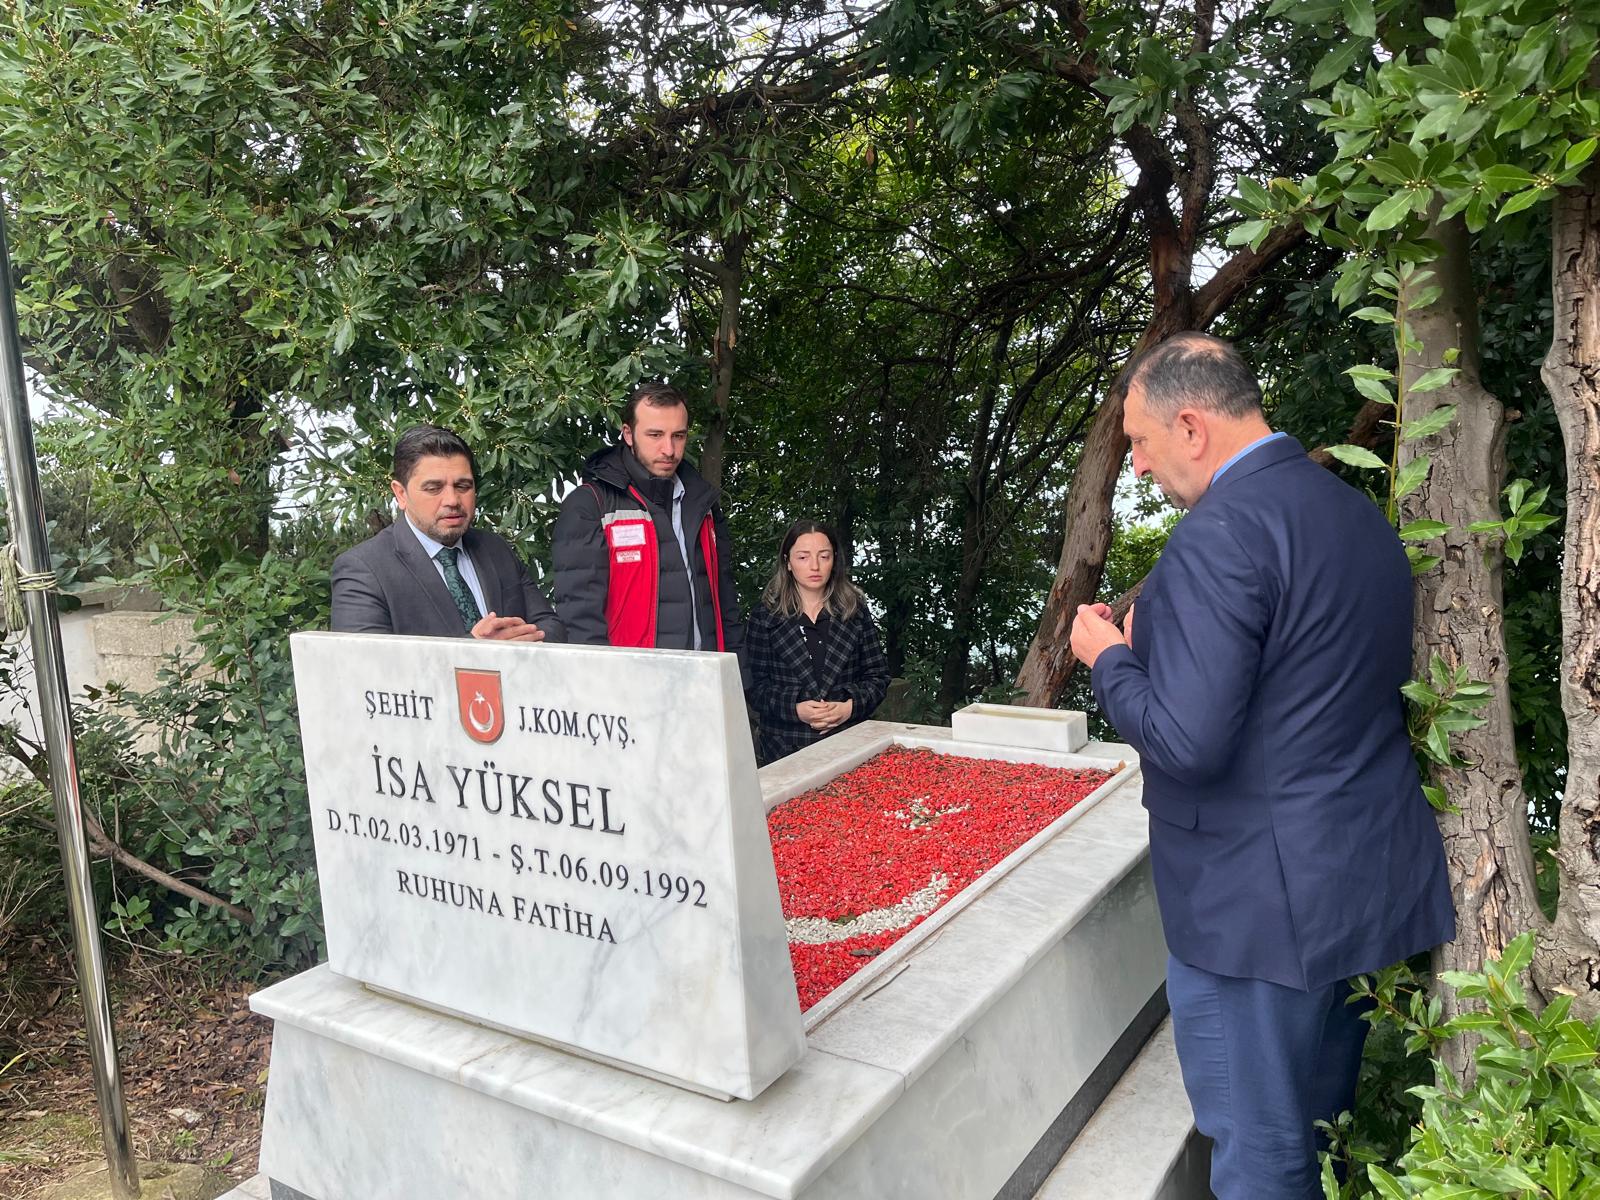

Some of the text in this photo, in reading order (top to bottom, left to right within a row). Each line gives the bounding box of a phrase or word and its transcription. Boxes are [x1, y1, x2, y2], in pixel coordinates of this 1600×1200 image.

[365, 690, 635, 749] ŞEHİT J.KOM.ÇVŞ.
[372, 745, 625, 836] İSA YÜKSEL
[327, 809, 481, 861] D.T.02.03.1971
[510, 844, 708, 909] Ş.T.06.09.1992
[397, 870, 618, 944] RUHUNA FATİHA
